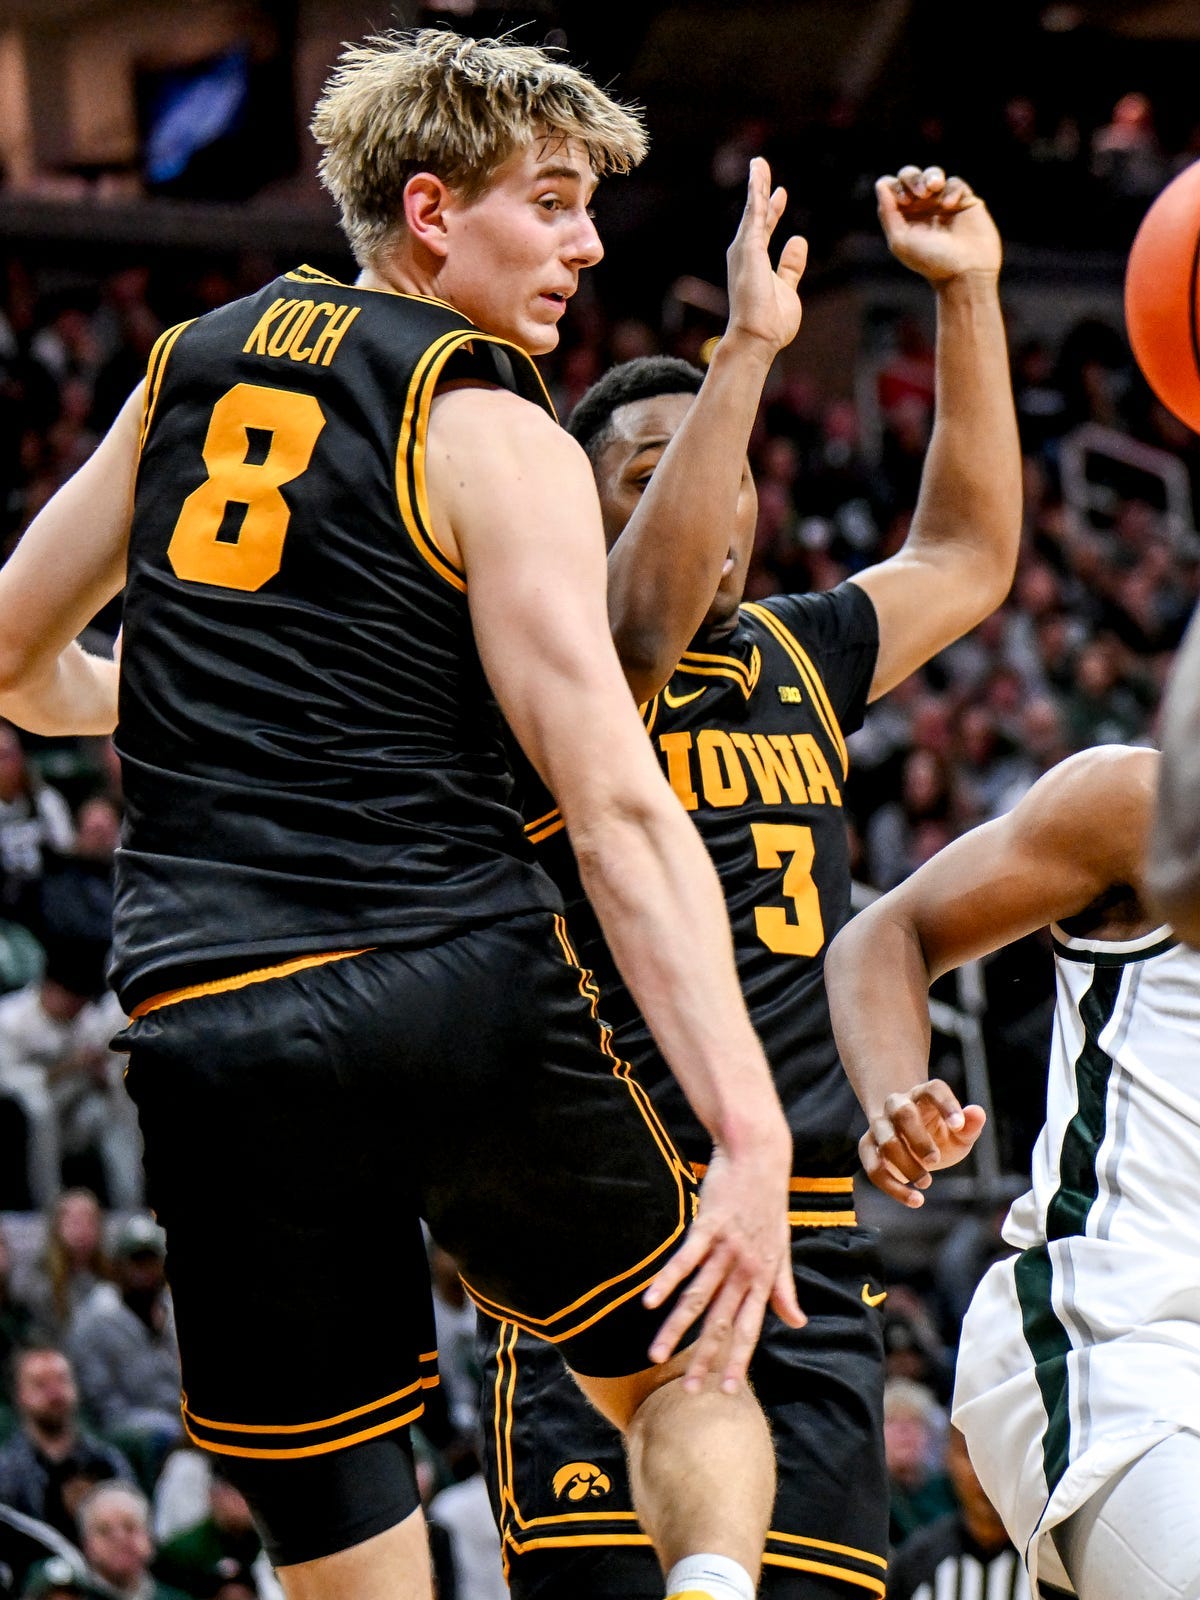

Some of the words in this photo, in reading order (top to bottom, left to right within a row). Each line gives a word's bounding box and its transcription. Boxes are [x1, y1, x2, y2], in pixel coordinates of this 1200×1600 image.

[242, 298, 362, 367] KOCH
[166, 382, 327, 593] 8
[659, 729, 842, 811] IOWA
[750, 823, 825, 957] 3
